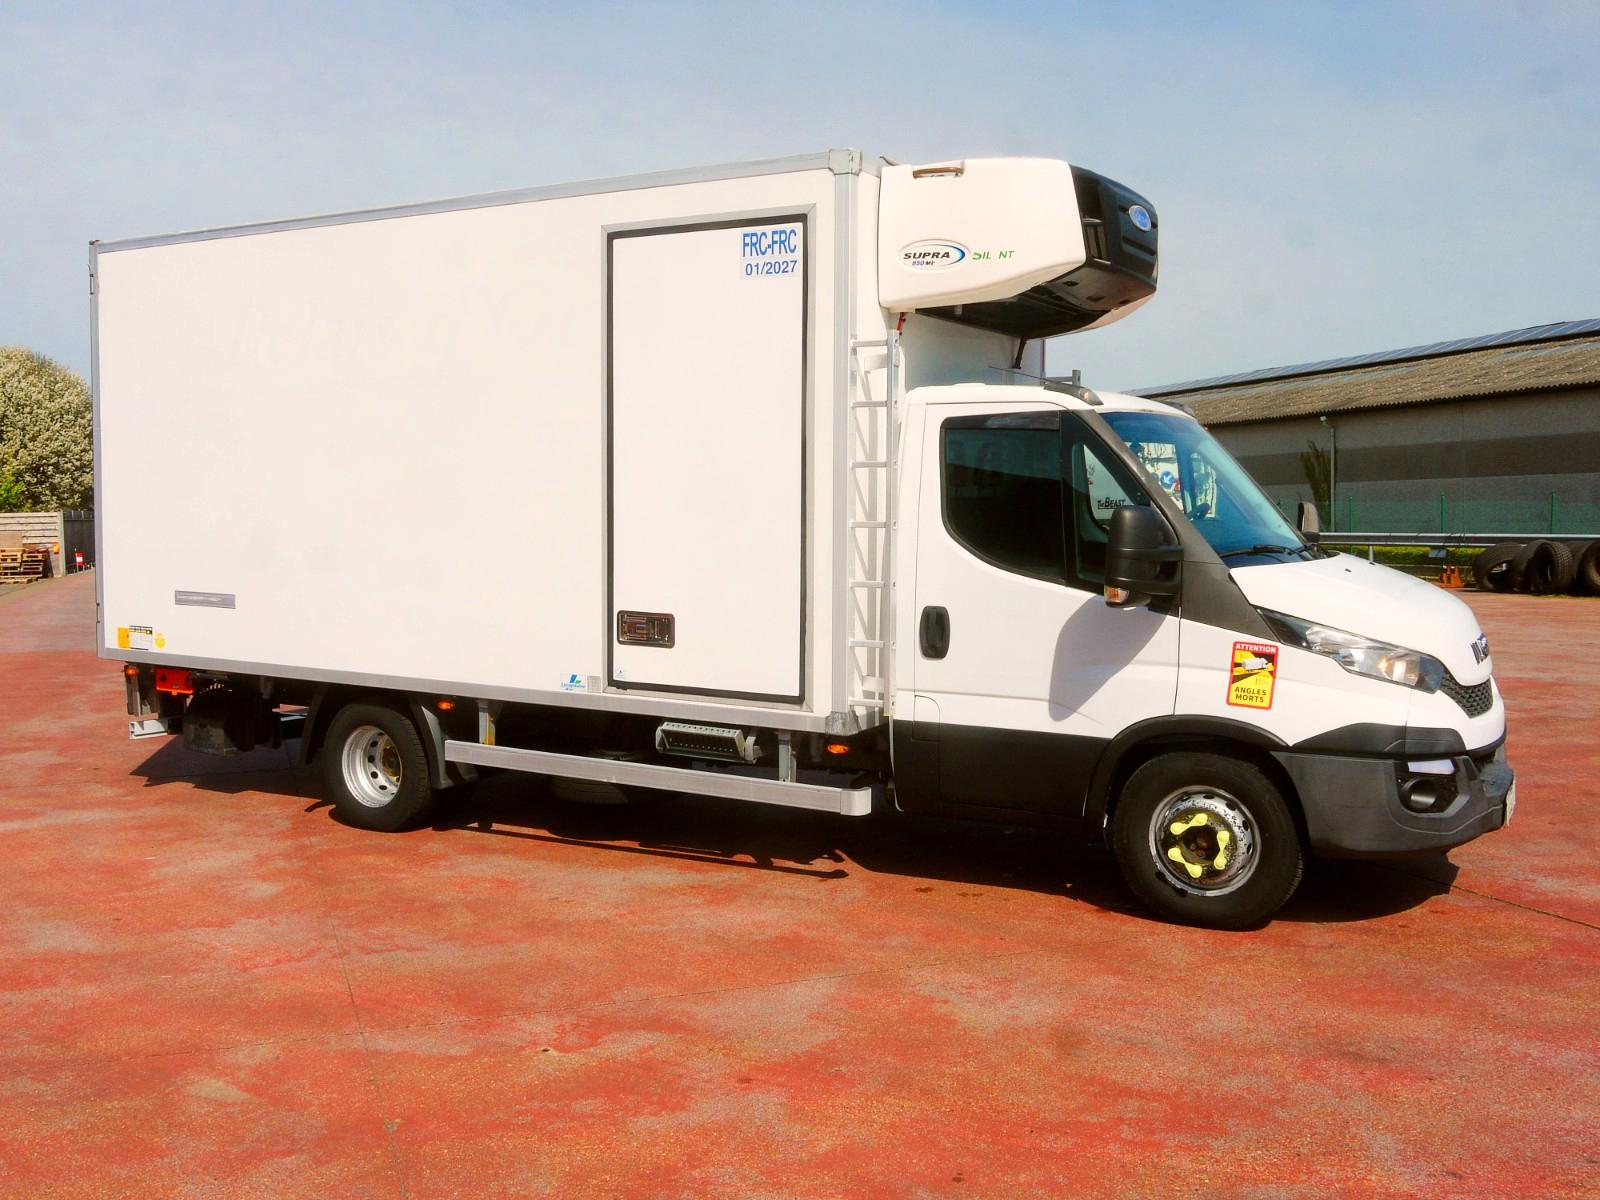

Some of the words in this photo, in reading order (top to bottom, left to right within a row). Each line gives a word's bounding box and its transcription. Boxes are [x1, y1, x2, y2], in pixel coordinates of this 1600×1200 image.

[742, 229, 797, 257] FRC-FRC
[903, 251, 950, 260] SUPRA
[745, 260, 798, 276] 01/2027
[1235, 643, 1277, 653] ATTENTION
[1234, 686, 1267, 696] ANGLES
[1235, 694, 1264, 703] MORTS
